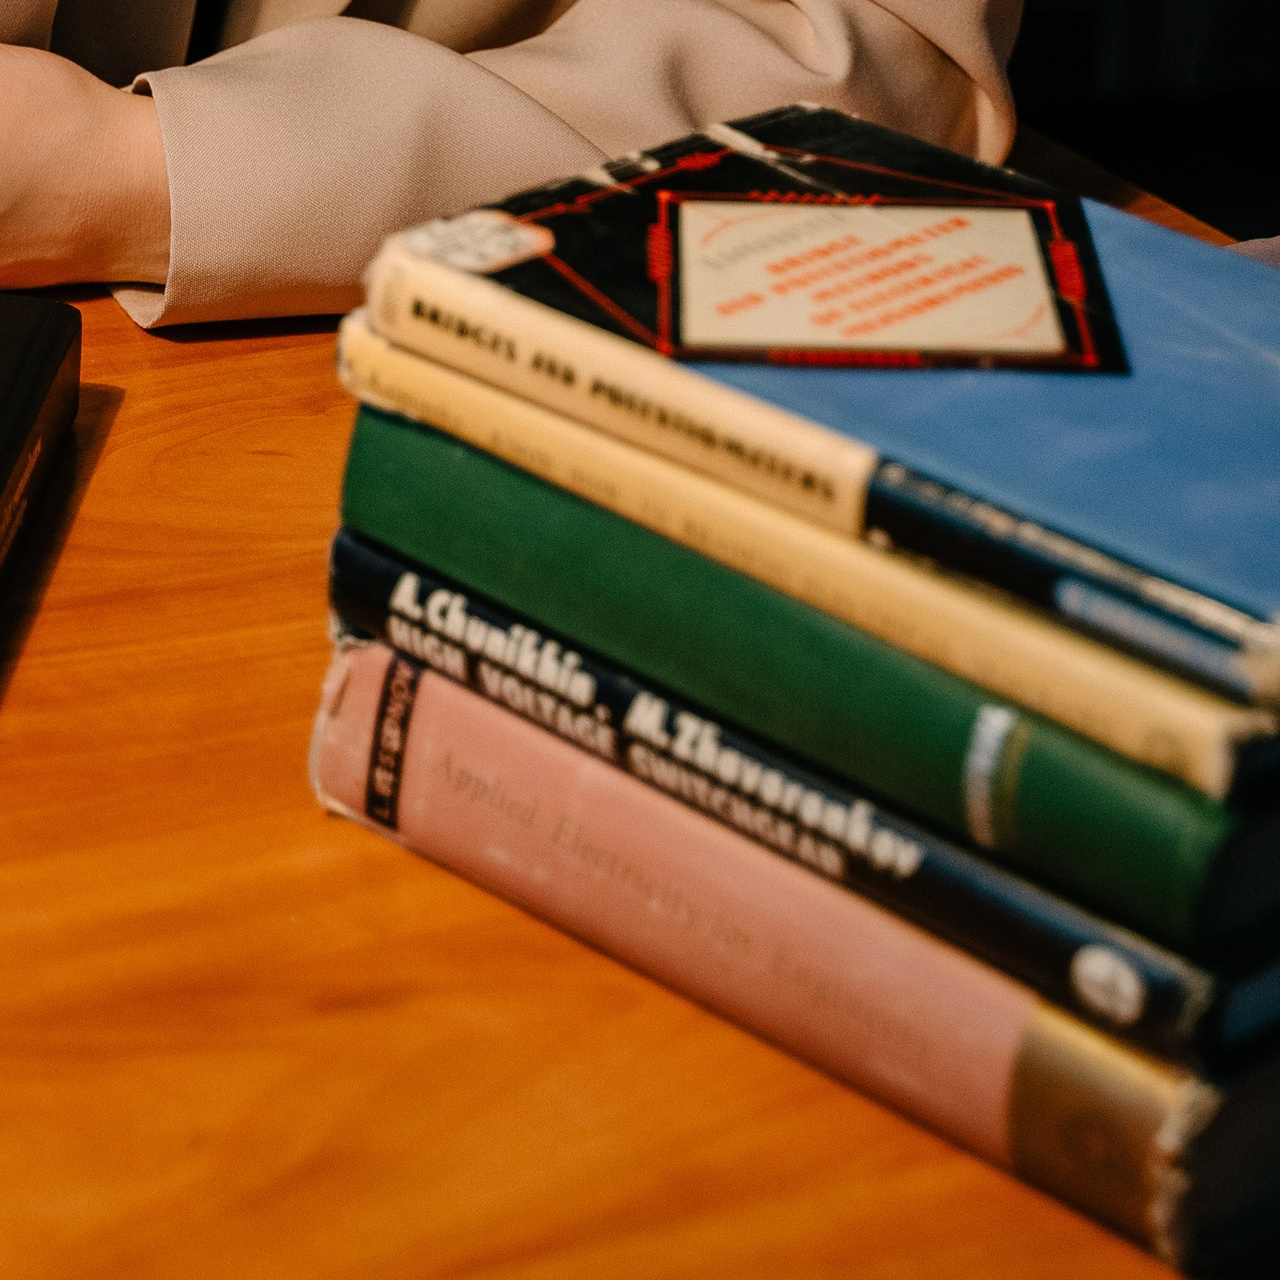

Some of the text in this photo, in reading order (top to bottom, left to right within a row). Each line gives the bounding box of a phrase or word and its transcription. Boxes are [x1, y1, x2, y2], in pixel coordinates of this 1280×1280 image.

[387, 613, 469, 682] HIGH
[477, 659, 616, 762] VOLTAGE
[435, 751, 540, 830] Applied
